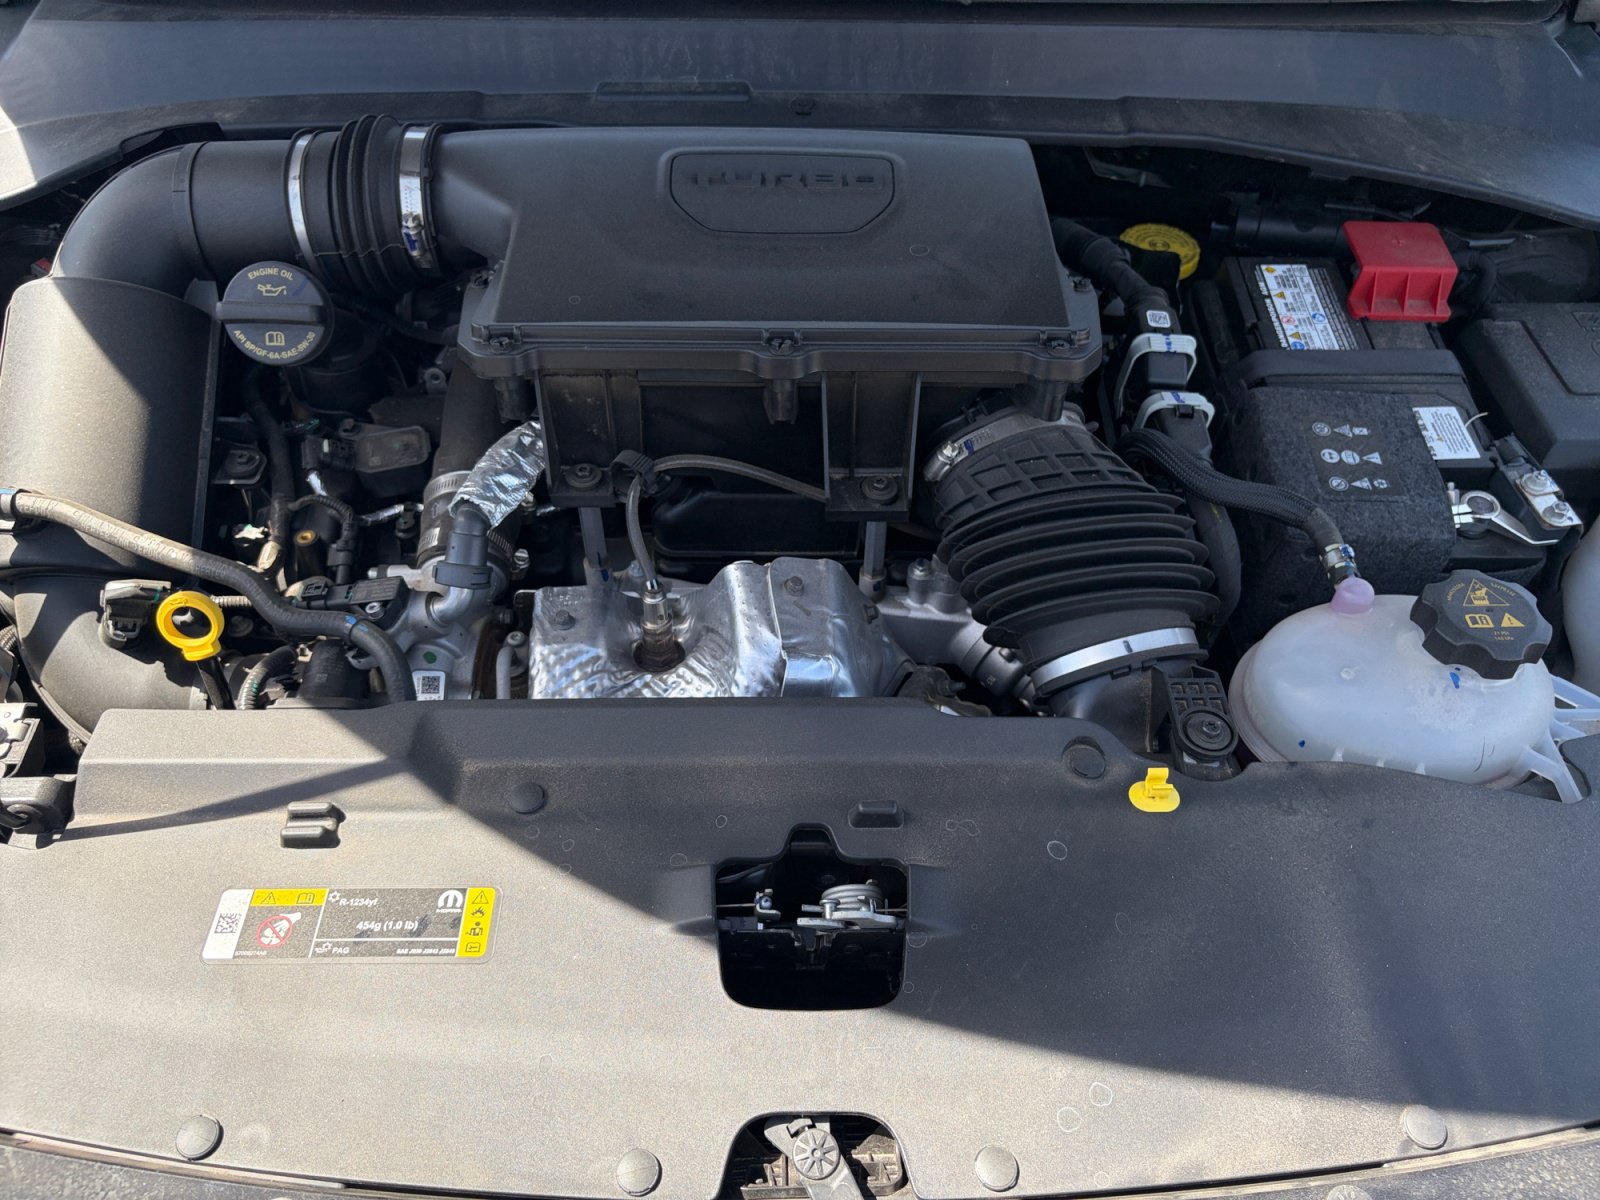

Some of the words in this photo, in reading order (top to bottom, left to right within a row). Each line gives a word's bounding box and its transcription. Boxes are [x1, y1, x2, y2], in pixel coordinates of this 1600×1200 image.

[248, 267, 279, 280] ENGINE
[280, 270, 293, 281] OIL
[233, 329, 246, 343] API
[339, 897, 378, 907] R-1234yf
[356, 920, 381, 932] 454g
[383, 920, 403, 932] (1.0
[404, 920, 419, 932] lb)
[331, 946, 350, 954] PAG
